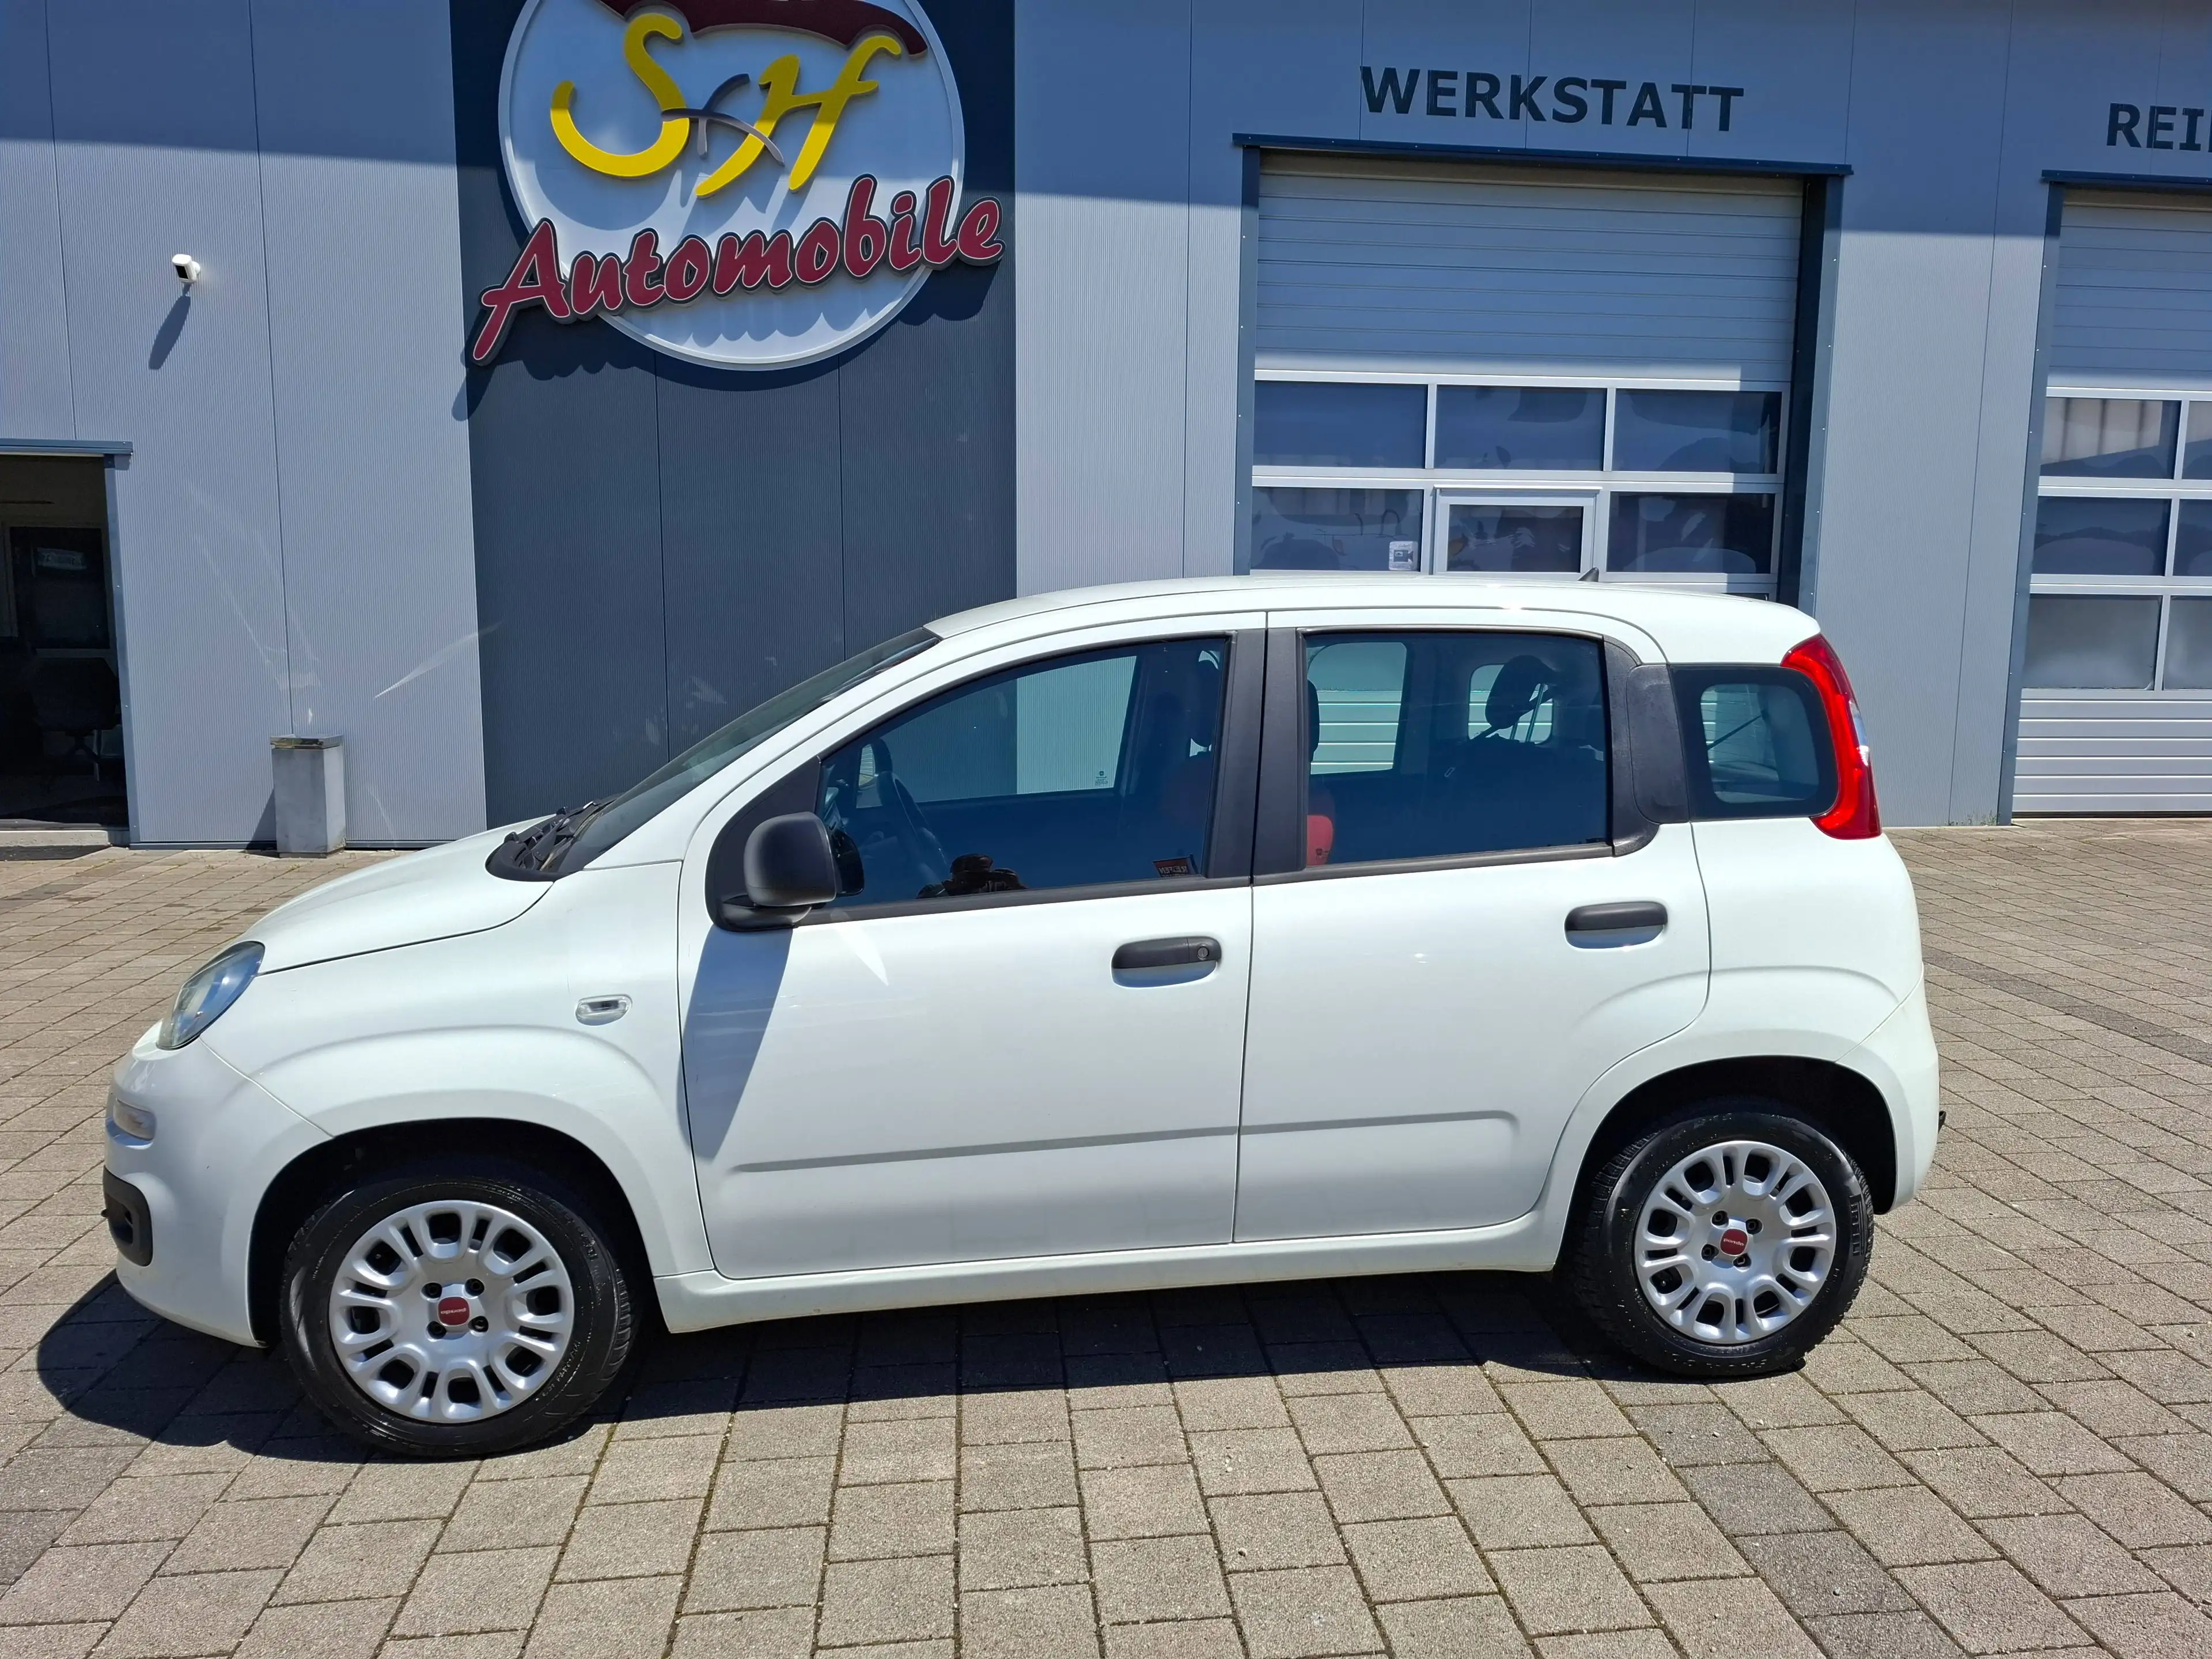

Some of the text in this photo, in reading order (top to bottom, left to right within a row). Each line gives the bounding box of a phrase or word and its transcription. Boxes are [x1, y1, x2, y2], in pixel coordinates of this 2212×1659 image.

[1360, 66, 1744, 131] WERKSTATT
[2106, 102, 2212, 153] REI
[472, 175, 1005, 365] Automobile
[1723, 1237, 1744, 1247] panda
